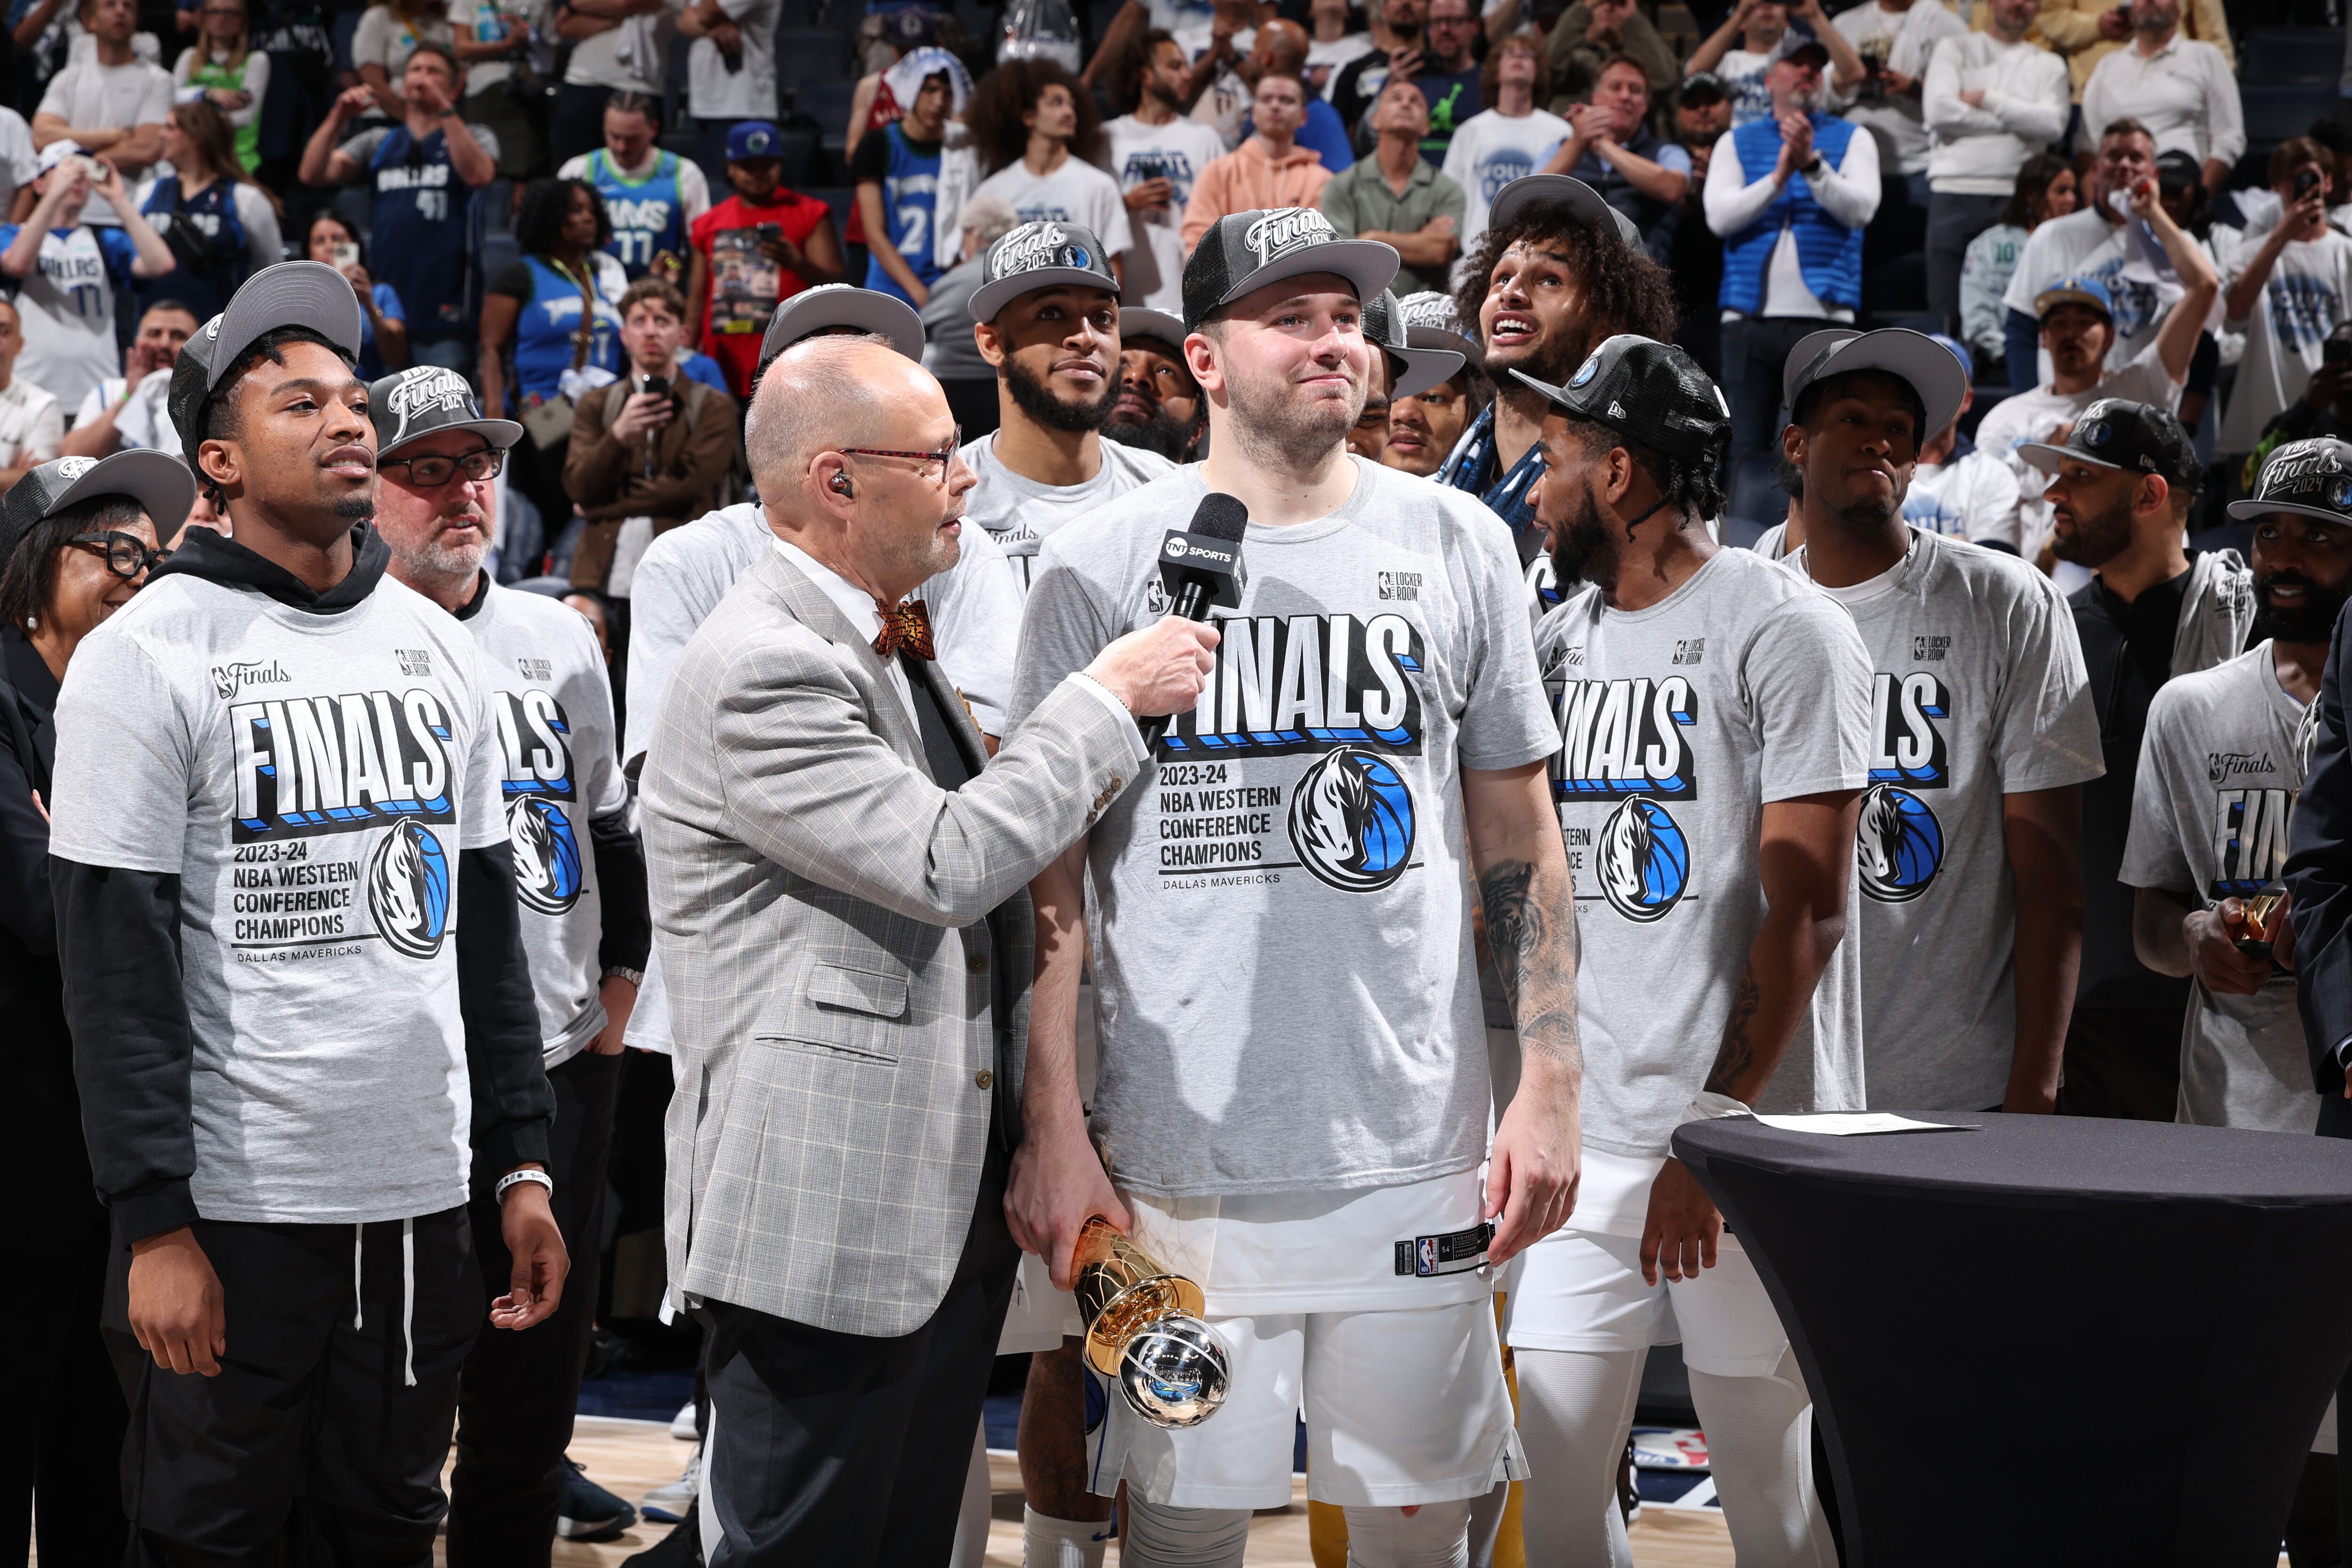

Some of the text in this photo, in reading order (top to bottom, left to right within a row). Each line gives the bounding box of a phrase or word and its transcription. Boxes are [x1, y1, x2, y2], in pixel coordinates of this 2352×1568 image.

[416, 189, 447, 222] 41
[897, 205, 934, 254] 2
[1245, 207, 1332, 268] Finals
[1304, 233, 1329, 246] 2024
[613, 231, 652, 265] 77
[992, 222, 1067, 279] Finals
[1025, 249, 1055, 271] 2024
[1419, 317, 1446, 329] 2024
[388, 367, 466, 444] Finals
[439, 393, 465, 411] 2024
[2282, 440, 2312, 457] NBA
[2258, 447, 2342, 501] Finals
[2292, 477, 2324, 494] 2024
[1166, 542, 1232, 563] TNT SPORTS
[1396, 572, 1422, 587] LOCKER
[1397, 586, 1417, 602] ROOM
[1928, 636, 1951, 648] LOCKER
[407, 649, 431, 663] LOCKER
[1685, 652, 1702, 665] ROOM
[1927, 648, 1946, 661] ROOM
[229, 660, 292, 699] Finals
[413, 663, 432, 677] ROOM
[1163, 614, 1417, 739] INALS
[232, 688, 451, 821] FINALS
[1159, 763, 1227, 786] 2023-24
[2216, 752, 2276, 784] Finals
[1160, 785, 1281, 813] NBA WESTERN
[1160, 814, 1271, 839] CONFERENCE
[1563, 828, 1591, 846] TERN
[234, 841, 307, 863] 2023-24
[1160, 840, 1262, 866] CHAMPIONS
[234, 860, 359, 888] NBA WESTERN
[1163, 873, 1280, 890] DALLAS MAVERICKS
[234, 888, 350, 914] CONFERENCE
[235, 914, 345, 940] CHAMPIONS
[237, 945, 362, 963] DALLAS MAVERICKS
